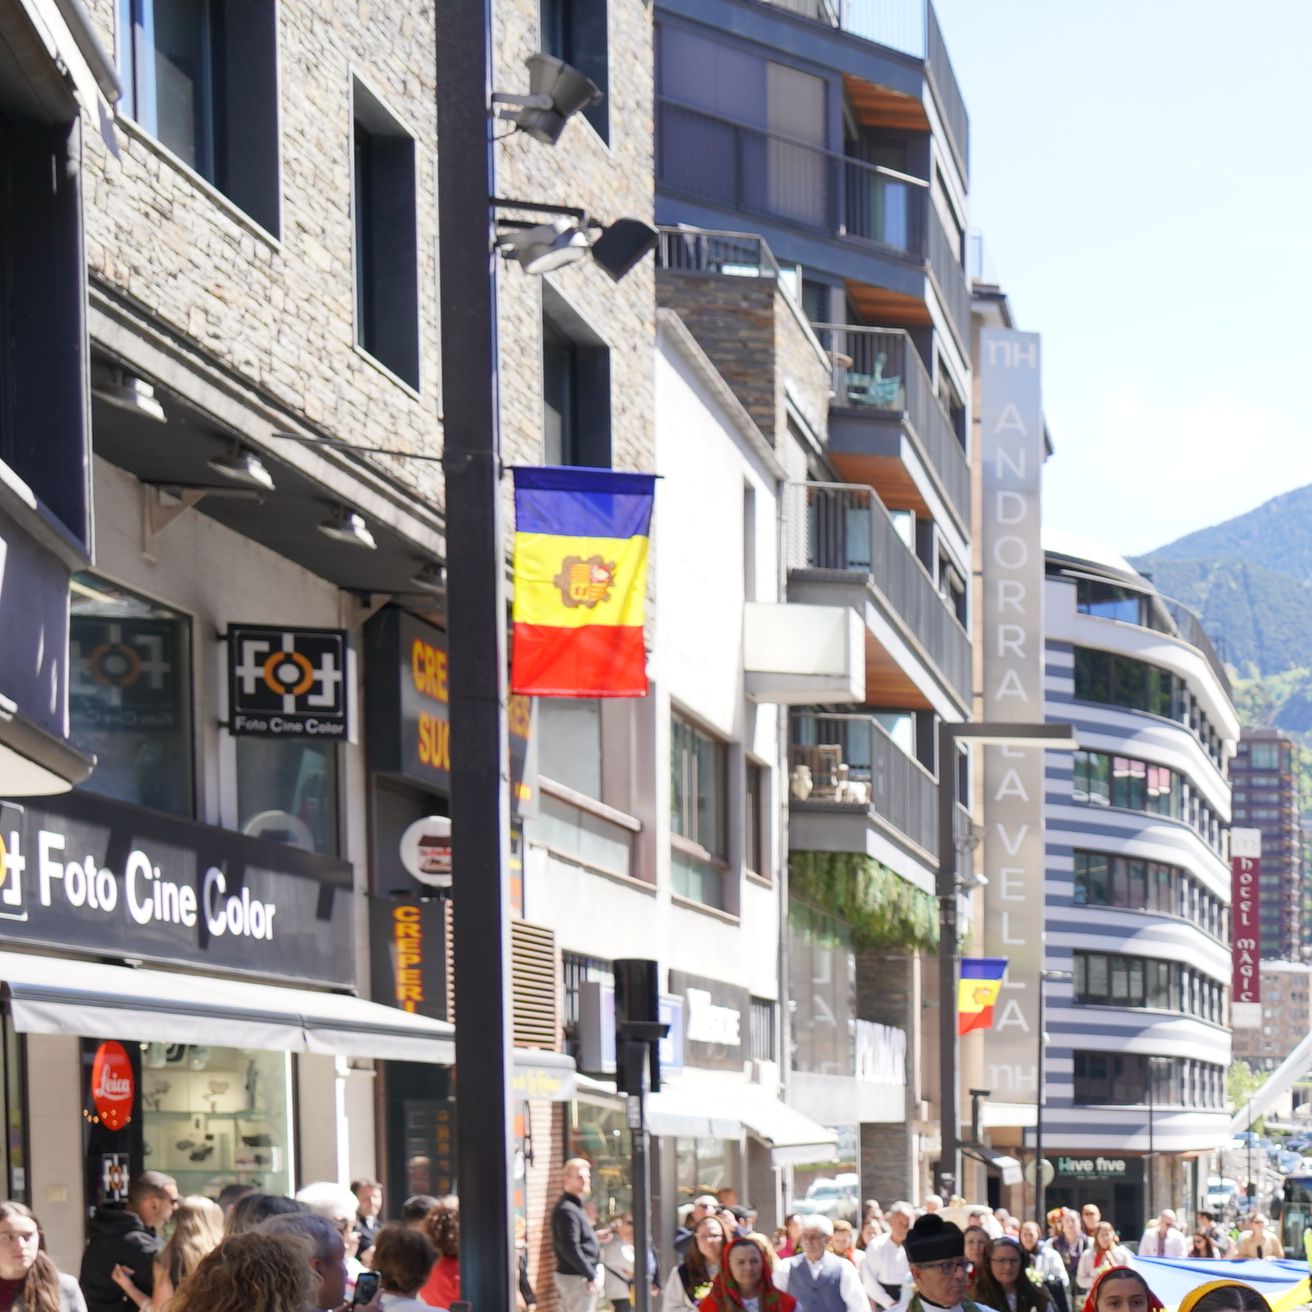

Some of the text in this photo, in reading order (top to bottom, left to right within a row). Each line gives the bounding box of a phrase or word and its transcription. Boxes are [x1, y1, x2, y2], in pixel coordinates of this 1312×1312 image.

[994, 403, 1028, 701] ANDORRA
[235, 717, 346, 735] Foto Cine Color
[38, 829, 277, 941] Foto Cine Color
[997, 824, 1029, 1033] VELLA
[96, 1064, 131, 1100] Leica
